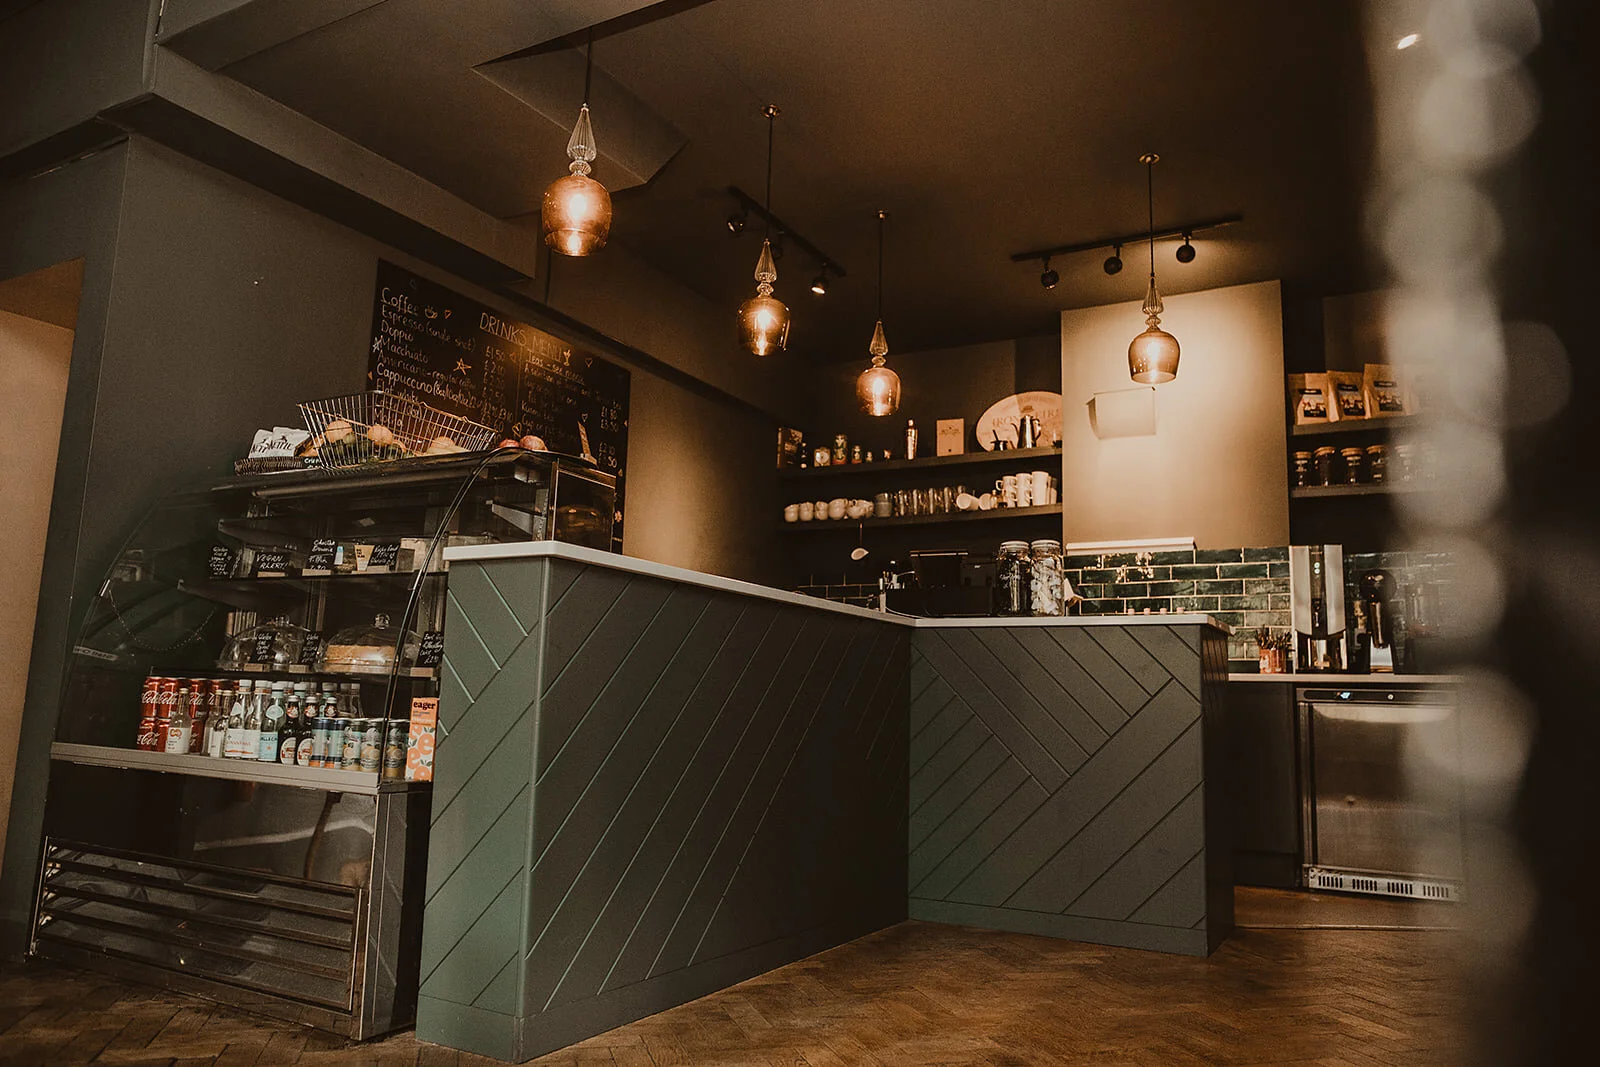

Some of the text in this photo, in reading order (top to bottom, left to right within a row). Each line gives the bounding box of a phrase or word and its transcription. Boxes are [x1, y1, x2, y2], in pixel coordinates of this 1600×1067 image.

[381, 287, 418, 314] Coffee
[381, 320, 414, 344] Doppio
[382, 305, 424, 332] Espresso
[379, 335, 429, 364] Macchiato
[480, 312, 563, 362] DRINKS MENU
[376, 362, 433, 395] Cappuccino
[413, 701, 436, 711] eager
